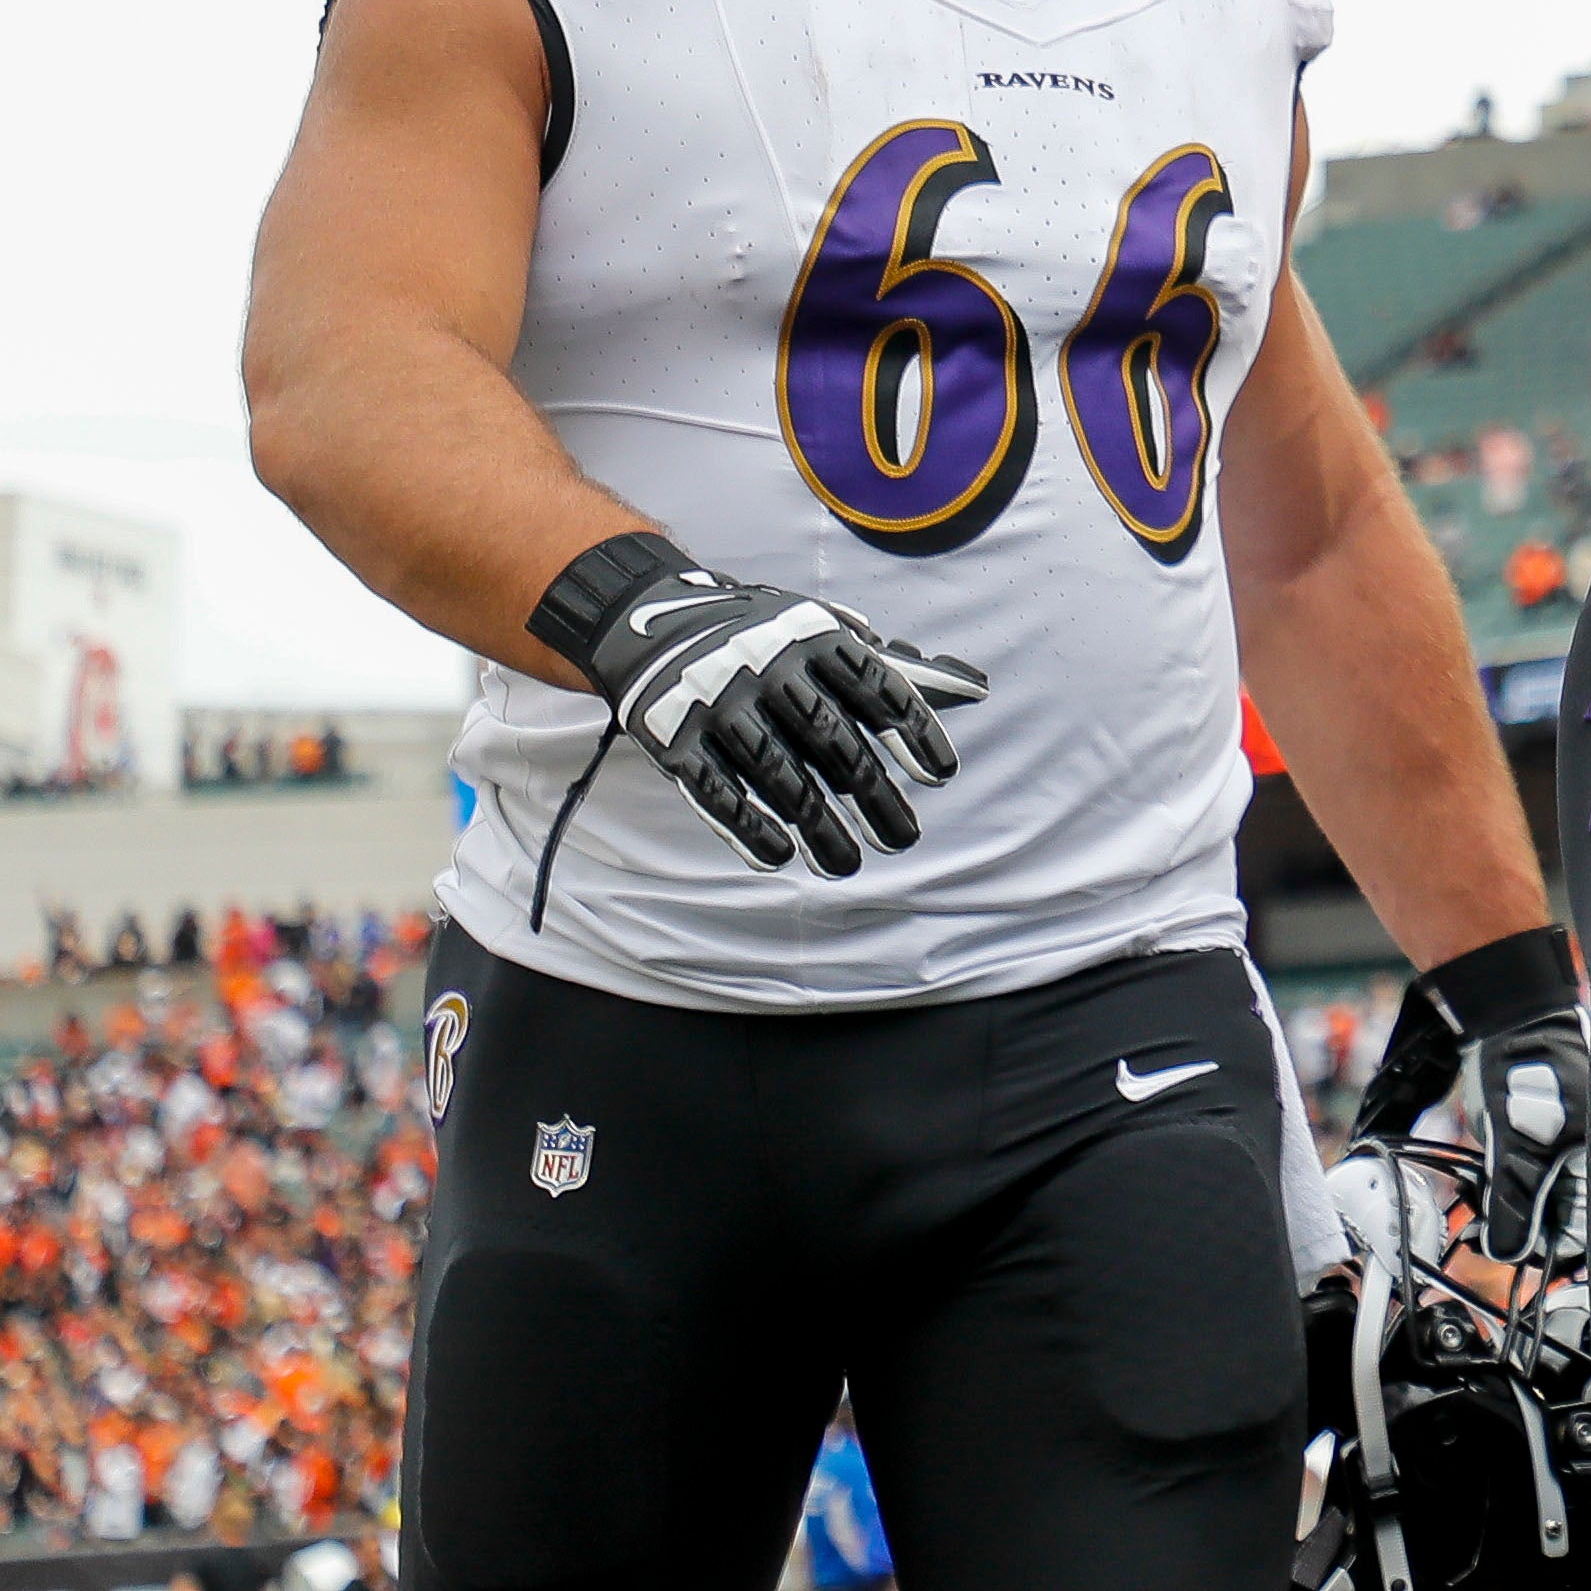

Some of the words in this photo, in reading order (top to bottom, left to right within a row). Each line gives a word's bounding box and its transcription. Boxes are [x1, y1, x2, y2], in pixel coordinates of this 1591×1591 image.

[976, 72, 1116, 100] RAVENS
[776, 118, 1233, 565] 66
[542, 1153, 579, 1181] NFL
